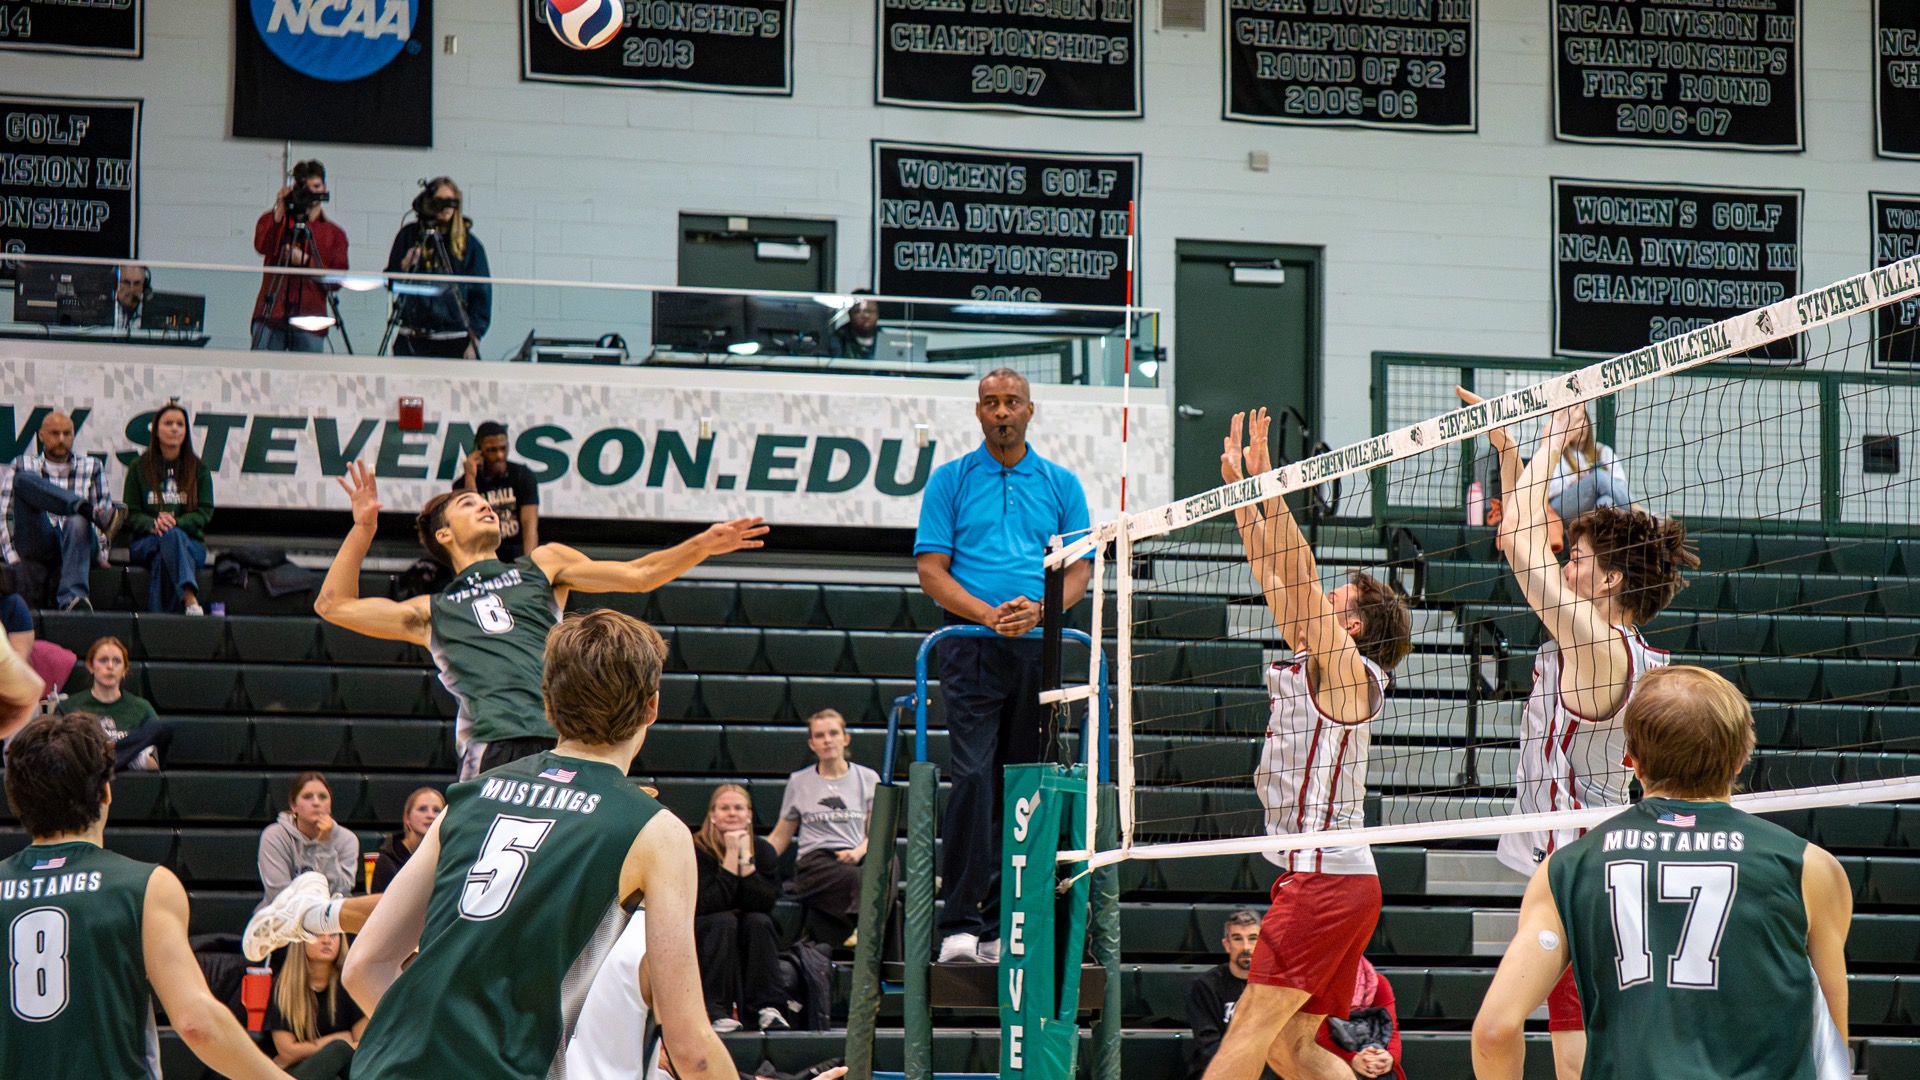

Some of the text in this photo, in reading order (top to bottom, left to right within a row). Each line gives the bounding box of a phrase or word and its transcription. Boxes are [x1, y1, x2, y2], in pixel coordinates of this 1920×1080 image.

[267, 0, 411, 41] NCAA
[1236, 17, 1467, 57] CHAMPIONSHIPS
[1560, 5, 1796, 43] NCAA DIVISION III
[622, 37, 695, 69] 2013
[890, 22, 1129, 64] CHAMPIONSHIPS
[1565, 37, 1787, 75] CHAMPIONSHIPS
[1880, 28, 1920, 56] NC
[971, 65, 1046, 96] 2007
[1256, 52, 1446, 89] ROUND OF 32
[1582, 70, 1771, 106] FIRST ROUND
[1284, 86, 1418, 119] 2005-06
[1617, 104, 1732, 136] 2006-07
[6, 112, 90, 146] GOLF
[0, 153, 131, 190] ISION III
[898, 158, 1117, 198] WOMEN'S GOLF
[881, 199, 959, 231] NCAA
[966, 203, 1095, 238] DIVISION
[1573, 196, 1782, 232] WOMEN'S GOLF
[1886, 208, 1920, 229] WO
[894, 242, 1118, 279] CHAMPIONSHIP
[1560, 234, 1798, 272] NCAA DIVISION III
[1879, 234, 1920, 261] NC
[1573, 274, 1784, 308] CHAMPIONSHIP
[472, 592, 515, 634] 6
[479, 777, 601, 815] MUSTANGS
[1602, 829, 1745, 852] MUSTANGS
[457, 814, 556, 921] 5
[0, 872, 102, 901] USTANGS
[1605, 859, 1738, 990] 17
[9, 905, 70, 1022] 8
